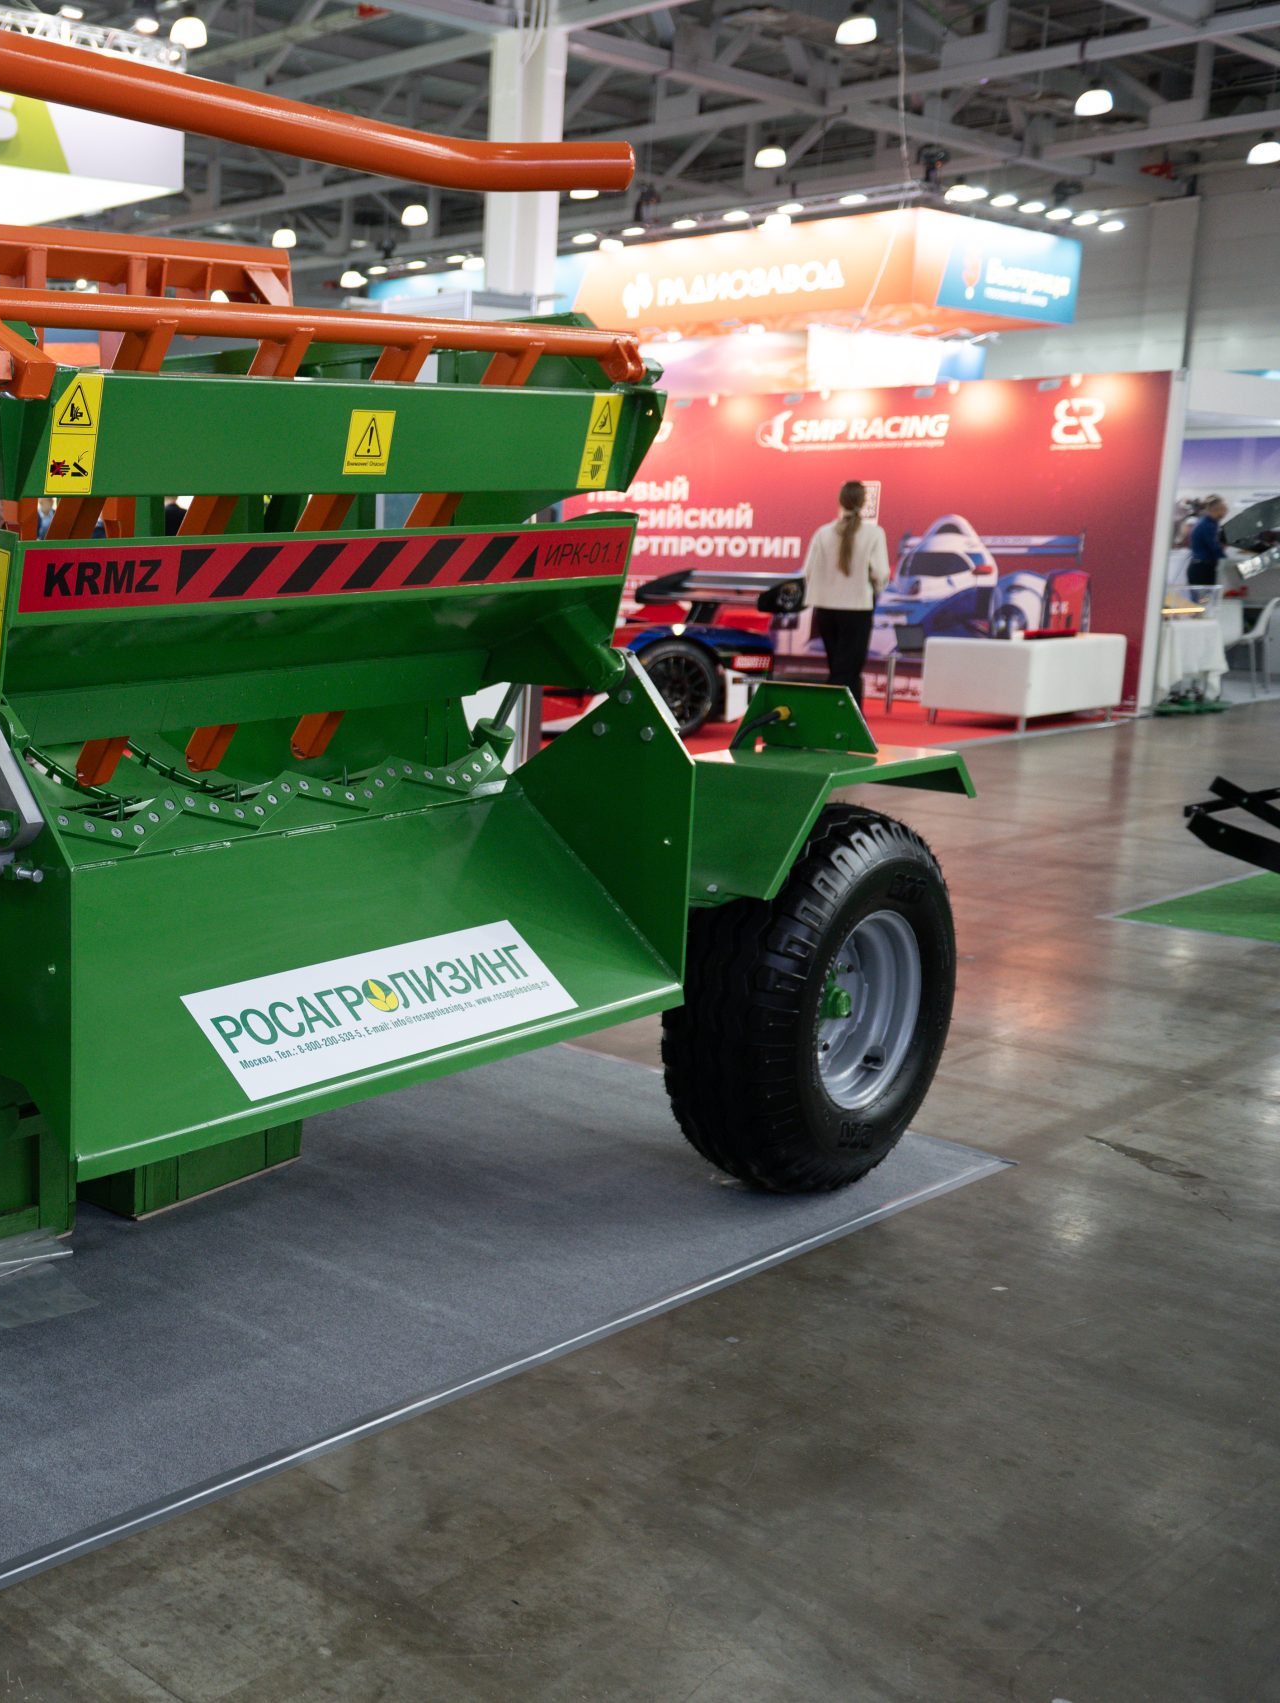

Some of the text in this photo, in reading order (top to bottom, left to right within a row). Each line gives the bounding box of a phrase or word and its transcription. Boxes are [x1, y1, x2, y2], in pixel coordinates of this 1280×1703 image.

[657, 258, 845, 307] РАДИОЗАВОД
[789, 414, 950, 443] SMP RACING
[632, 535, 802, 559] РТПРОТОТИП
[43, 559, 162, 598] KRMZ
[209, 944, 530, 1055] РОСАГРОЛИЗИНГ
[239, 1054, 277, 1070] Москва,
